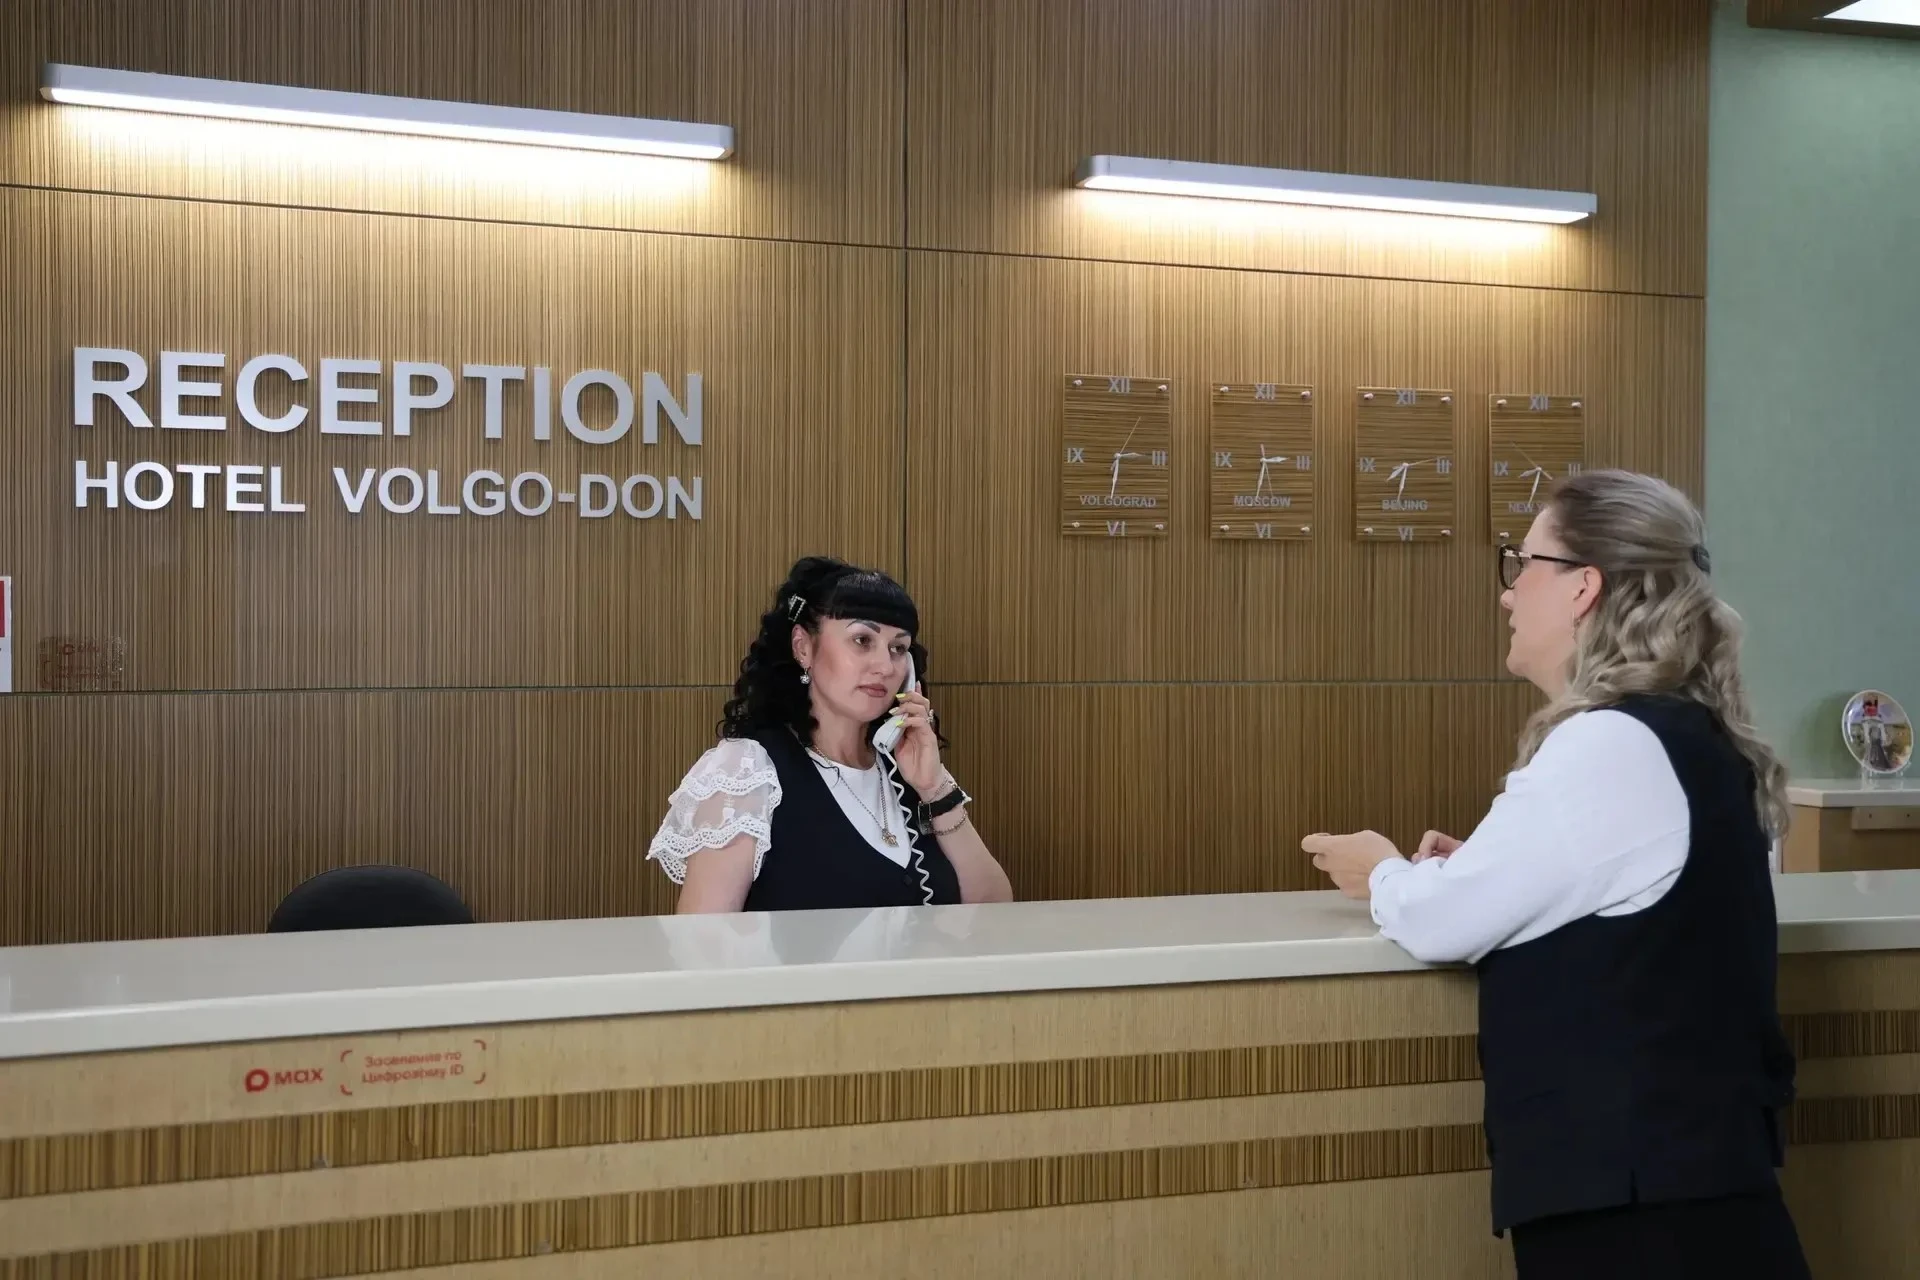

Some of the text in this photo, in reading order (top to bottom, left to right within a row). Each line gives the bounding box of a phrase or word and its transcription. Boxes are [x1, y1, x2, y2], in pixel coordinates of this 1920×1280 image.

[1108, 377, 1130, 394] XII
[1255, 384, 1275, 400] XII
[73, 346, 703, 446] RECEPTION
[1396, 389, 1416, 405] XII
[1529, 395, 1548, 411] XII
[1067, 447, 1084, 464] IX
[1152, 451, 1168, 466] III
[1215, 452, 1232, 468] IX
[1296, 455, 1311, 470] III
[1359, 457, 1376, 473] IX
[1494, 461, 1509, 476] IX
[74, 460, 702, 520] HOTEL VOLGO-DON
[1079, 495, 1157, 508] VOLGOGRAD
[1234, 495, 1291, 508] MOSCOW
[1381, 500, 1428, 512] BEIJING
[1509, 502, 1532, 513] NEW
[1106, 520, 1125, 537] VI
[1255, 523, 1271, 539] VI
[1397, 527, 1414, 541] VI
[450, 1063, 465, 1075] ID
